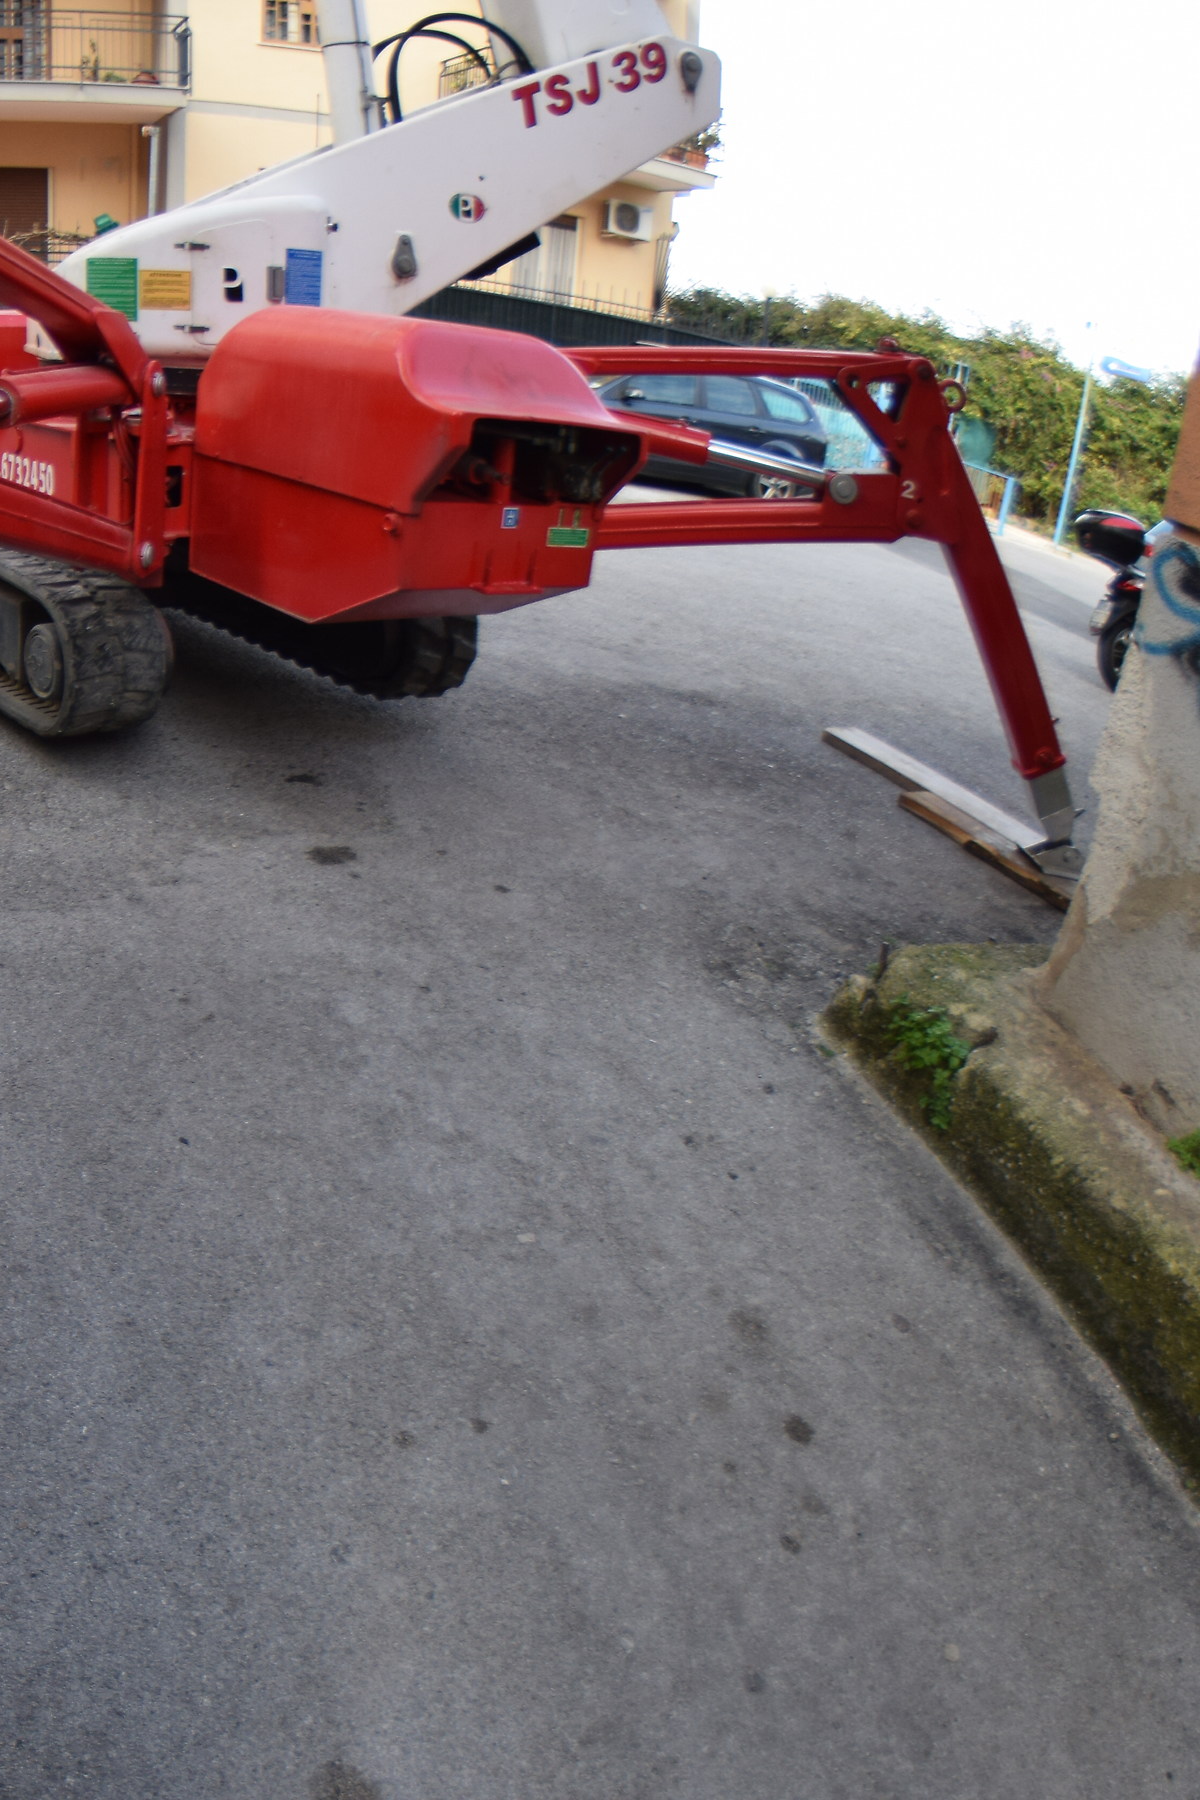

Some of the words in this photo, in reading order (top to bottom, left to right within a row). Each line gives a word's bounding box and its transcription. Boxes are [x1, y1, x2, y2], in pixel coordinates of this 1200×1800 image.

[511, 61, 601, 128] TSJ
[611, 42, 667, 94] 39
[900, 480, 917, 499] 2
